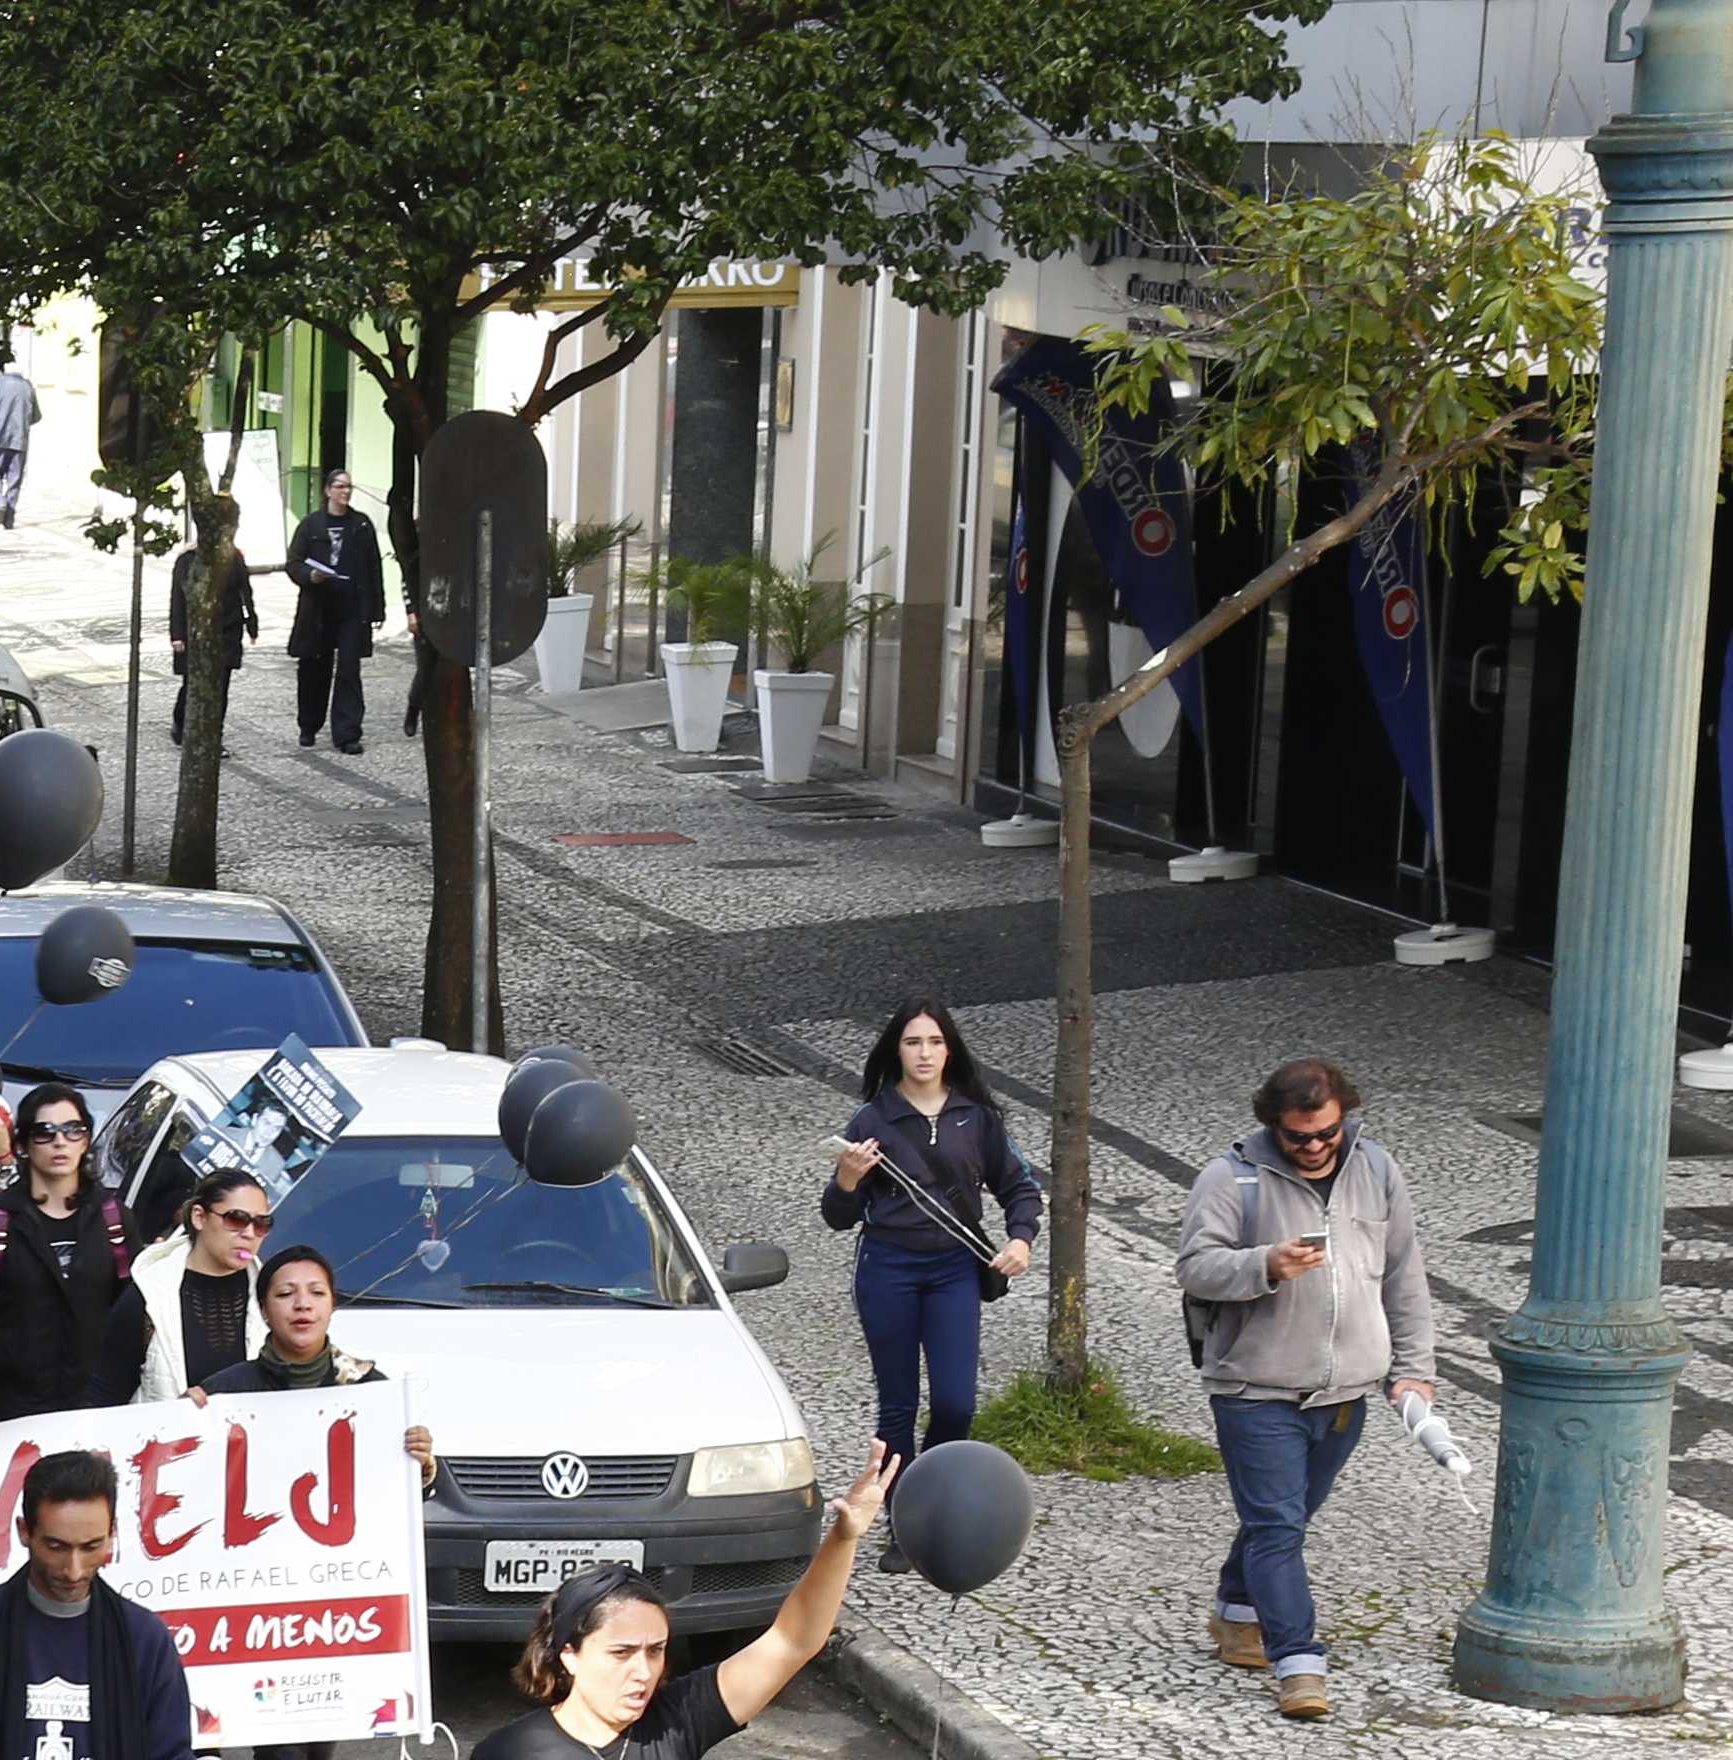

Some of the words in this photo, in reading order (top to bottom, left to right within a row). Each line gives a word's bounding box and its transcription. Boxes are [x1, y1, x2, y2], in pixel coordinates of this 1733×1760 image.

[162, 1573, 189, 1595] DE
[200, 1566, 299, 1590] RAFAEL
[309, 1560, 393, 1584] GRECA
[209, 1620, 233, 1652] A
[246, 1606, 384, 1650] MENOS
[280, 1673, 344, 1688] RESISTIR
[283, 1692, 295, 1706] E
[297, 1689, 344, 1705] LUTAR
